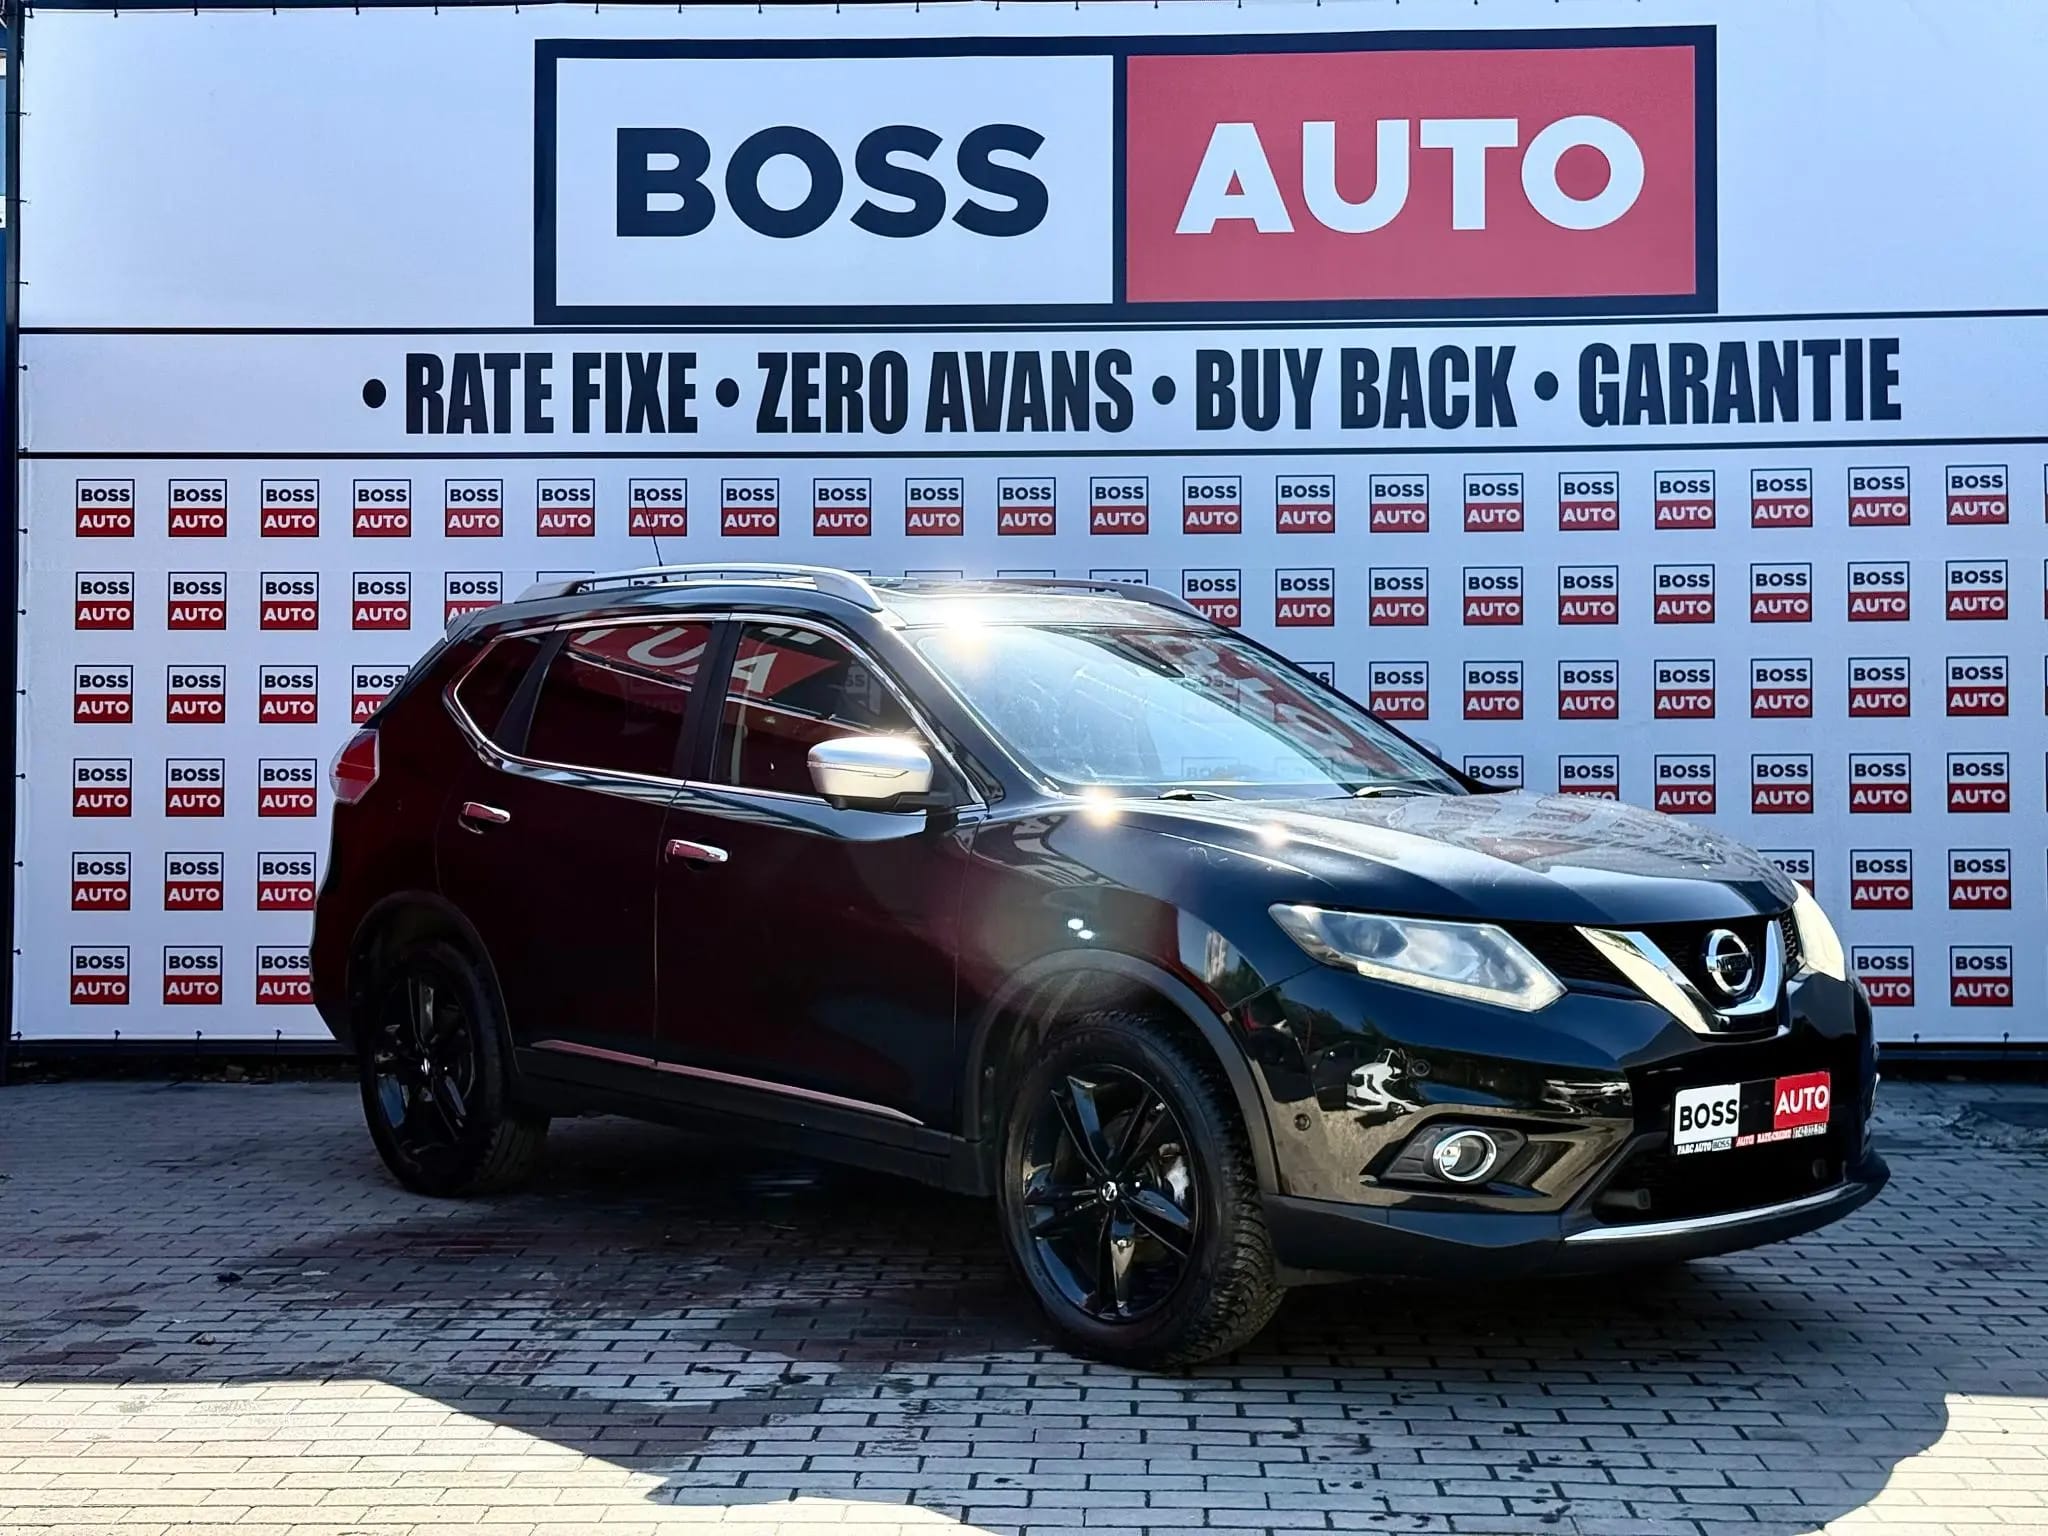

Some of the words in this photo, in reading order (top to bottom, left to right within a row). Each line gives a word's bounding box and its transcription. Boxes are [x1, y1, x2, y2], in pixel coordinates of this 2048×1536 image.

[616, 124, 1049, 238] BOSS
[1175, 115, 1645, 233] AUTO
[405, 352, 554, 434] RATE
[572, 351, 698, 434] FIXE
[756, 350, 909, 434] ZERO
[924, 348, 1134, 433] AVANS
[1195, 347, 1323, 431] BUY
[1340, 345, 1518, 430] BACK
[1578, 338, 1902, 427] GARANTIE
[1563, 481, 1615, 496] BOSS
[1659, 479, 1711, 494] BOSS
[1756, 478, 1808, 493] BOSS
[1853, 476, 1905, 491] BOSS
[1951, 474, 2004, 489] BOSS
[80, 488, 131, 503] BOSS
[173, 488, 223, 503] BOSS
[265, 488, 315, 503] BOSS
[357, 488, 407, 503] BOSS
[449, 488, 499, 502] BOSS
[541, 488, 591, 502] BOSS
[633, 487, 683, 502] BOSS
[725, 487, 775, 502] BOSS
[818, 487, 867, 502] BOSS
[910, 487, 959, 501] BOSS
[1002, 486, 1052, 501] BOSS
[1095, 485, 1145, 500] BOSS
[1187, 485, 1237, 499] BOSS
[1280, 484, 1331, 499] BOSS
[1374, 483, 1425, 498] BOSS
[1468, 482, 1519, 497] BOSS
[1467, 508, 1521, 523] AUTO
[1562, 507, 1617, 522] AUTO
[1658, 506, 1713, 521] AUTO
[1754, 504, 1810, 519] AUTO
[1852, 502, 1907, 518] AUTO
[1950, 501, 2006, 516] AUTO
[79, 514, 131, 528] AUTO
[171, 514, 224, 529] AUTO
[264, 514, 316, 529] AUTO
[356, 514, 408, 529] AUTO
[448, 514, 500, 529] AUTO
[539, 514, 592, 528] AUTO
[632, 513, 684, 528] AUTO
[724, 513, 777, 528] AUTO
[816, 513, 868, 528] AUTO
[908, 513, 961, 527] AUTO
[1000, 512, 1053, 527] AUTO
[1093, 512, 1146, 526] AUTO
[1186, 511, 1239, 526] AUTO
[1279, 510, 1332, 525] AUTO
[1373, 509, 1426, 524] AUTO
[1280, 577, 1330, 592] BOSS
[1374, 576, 1424, 591] BOSS
[1468, 575, 1519, 591] BOSS
[1563, 575, 1614, 590] BOSS
[1659, 573, 1711, 588] BOSS
[1755, 572, 1808, 587] BOSS
[1852, 571, 1905, 586] BOSS
[1951, 569, 2004, 585] BOSS
[80, 581, 130, 595] BOSS
[173, 581, 223, 595] BOSS
[265, 581, 315, 595] BOSS
[357, 581, 407, 595] BOSS
[449, 581, 499, 594] BOSS
[1187, 578, 1237, 592] BOSS
[1199, 604, 1239, 619] UTO
[1278, 603, 1332, 618] AUTO
[1372, 603, 1426, 618] AUTO
[1466, 602, 1520, 617] AUTO
[1561, 601, 1616, 616] AUTO
[1657, 600, 1712, 615] AUTO
[1753, 599, 1809, 614] AUTO
[1851, 597, 1907, 613] AUTO
[1949, 596, 2005, 612] AUTO
[78, 607, 131, 621] AUTO
[171, 607, 224, 621] AUTO
[263, 607, 316, 621] AUTO
[355, 607, 408, 621] AUTO
[1374, 671, 1425, 685] BOSS
[1468, 670, 1519, 685] BOSS
[1563, 669, 1615, 684] BOSS
[1659, 668, 1711, 684] BOSS
[1755, 667, 1808, 683] BOSS
[1853, 666, 1906, 682] BOSS
[1951, 665, 2004, 681] BOSS
[79, 674, 129, 689] BOSS
[171, 674, 222, 689] BOSS
[264, 674, 314, 689] BOSS
[77, 700, 130, 715] AUTO
[170, 700, 222, 715] AUTO
[262, 700, 315, 715] AUTO
[354, 700, 381, 714] AU
[1372, 697, 1426, 711] AUTO
[1466, 696, 1520, 711] AUTO
[1561, 696, 1616, 711] AUTO
[1657, 695, 1712, 710] AUTO
[1754, 694, 1810, 709] AUTO
[1851, 693, 1907, 709] AUTO
[1950, 692, 2006, 708] AUTO
[77, 767, 128, 782] BOSS
[170, 767, 221, 782] BOSS
[263, 768, 313, 782] BOSS
[1468, 765, 1519, 779] BOSS
[1563, 764, 1615, 779] BOSS
[1659, 764, 1712, 779] BOSS
[1756, 763, 1809, 778] BOSS
[1854, 762, 1907, 778] BOSS
[1952, 762, 2005, 777] BOSS
[75, 794, 129, 808] AUTO
[169, 794, 221, 808] AUTO
[261, 794, 314, 808] AUTO
[1658, 791, 1713, 805] AUTO
[1755, 790, 1810, 805] AUTO
[1853, 789, 1908, 805] AUTO
[1951, 789, 2007, 804] AUTO
[76, 861, 127, 876] BOSS
[169, 861, 220, 876] BOSS
[262, 861, 312, 875] BOSS
[1855, 858, 1908, 874] BOSS
[1953, 858, 2007, 874] BOSS
[75, 887, 127, 902] AUTO
[167, 887, 220, 902] AUTO
[260, 887, 313, 902] AUTO
[1854, 886, 1910, 901] AUTO
[1952, 886, 2008, 901] AUTO
[75, 955, 126, 970] BOSS
[168, 955, 219, 970] BOSS
[260, 955, 310, 969] BOSS
[1857, 955, 1909, 970] BOSS
[1955, 955, 2008, 971] BOSS
[74, 981, 126, 996] AUTO
[167, 981, 219, 996] AUTO
[259, 981, 311, 996] AUTO
[1954, 983, 2010, 998] AUTO
[1775, 1085, 1829, 1116] AUTO
[1679, 1099, 1738, 1132] BOSS
